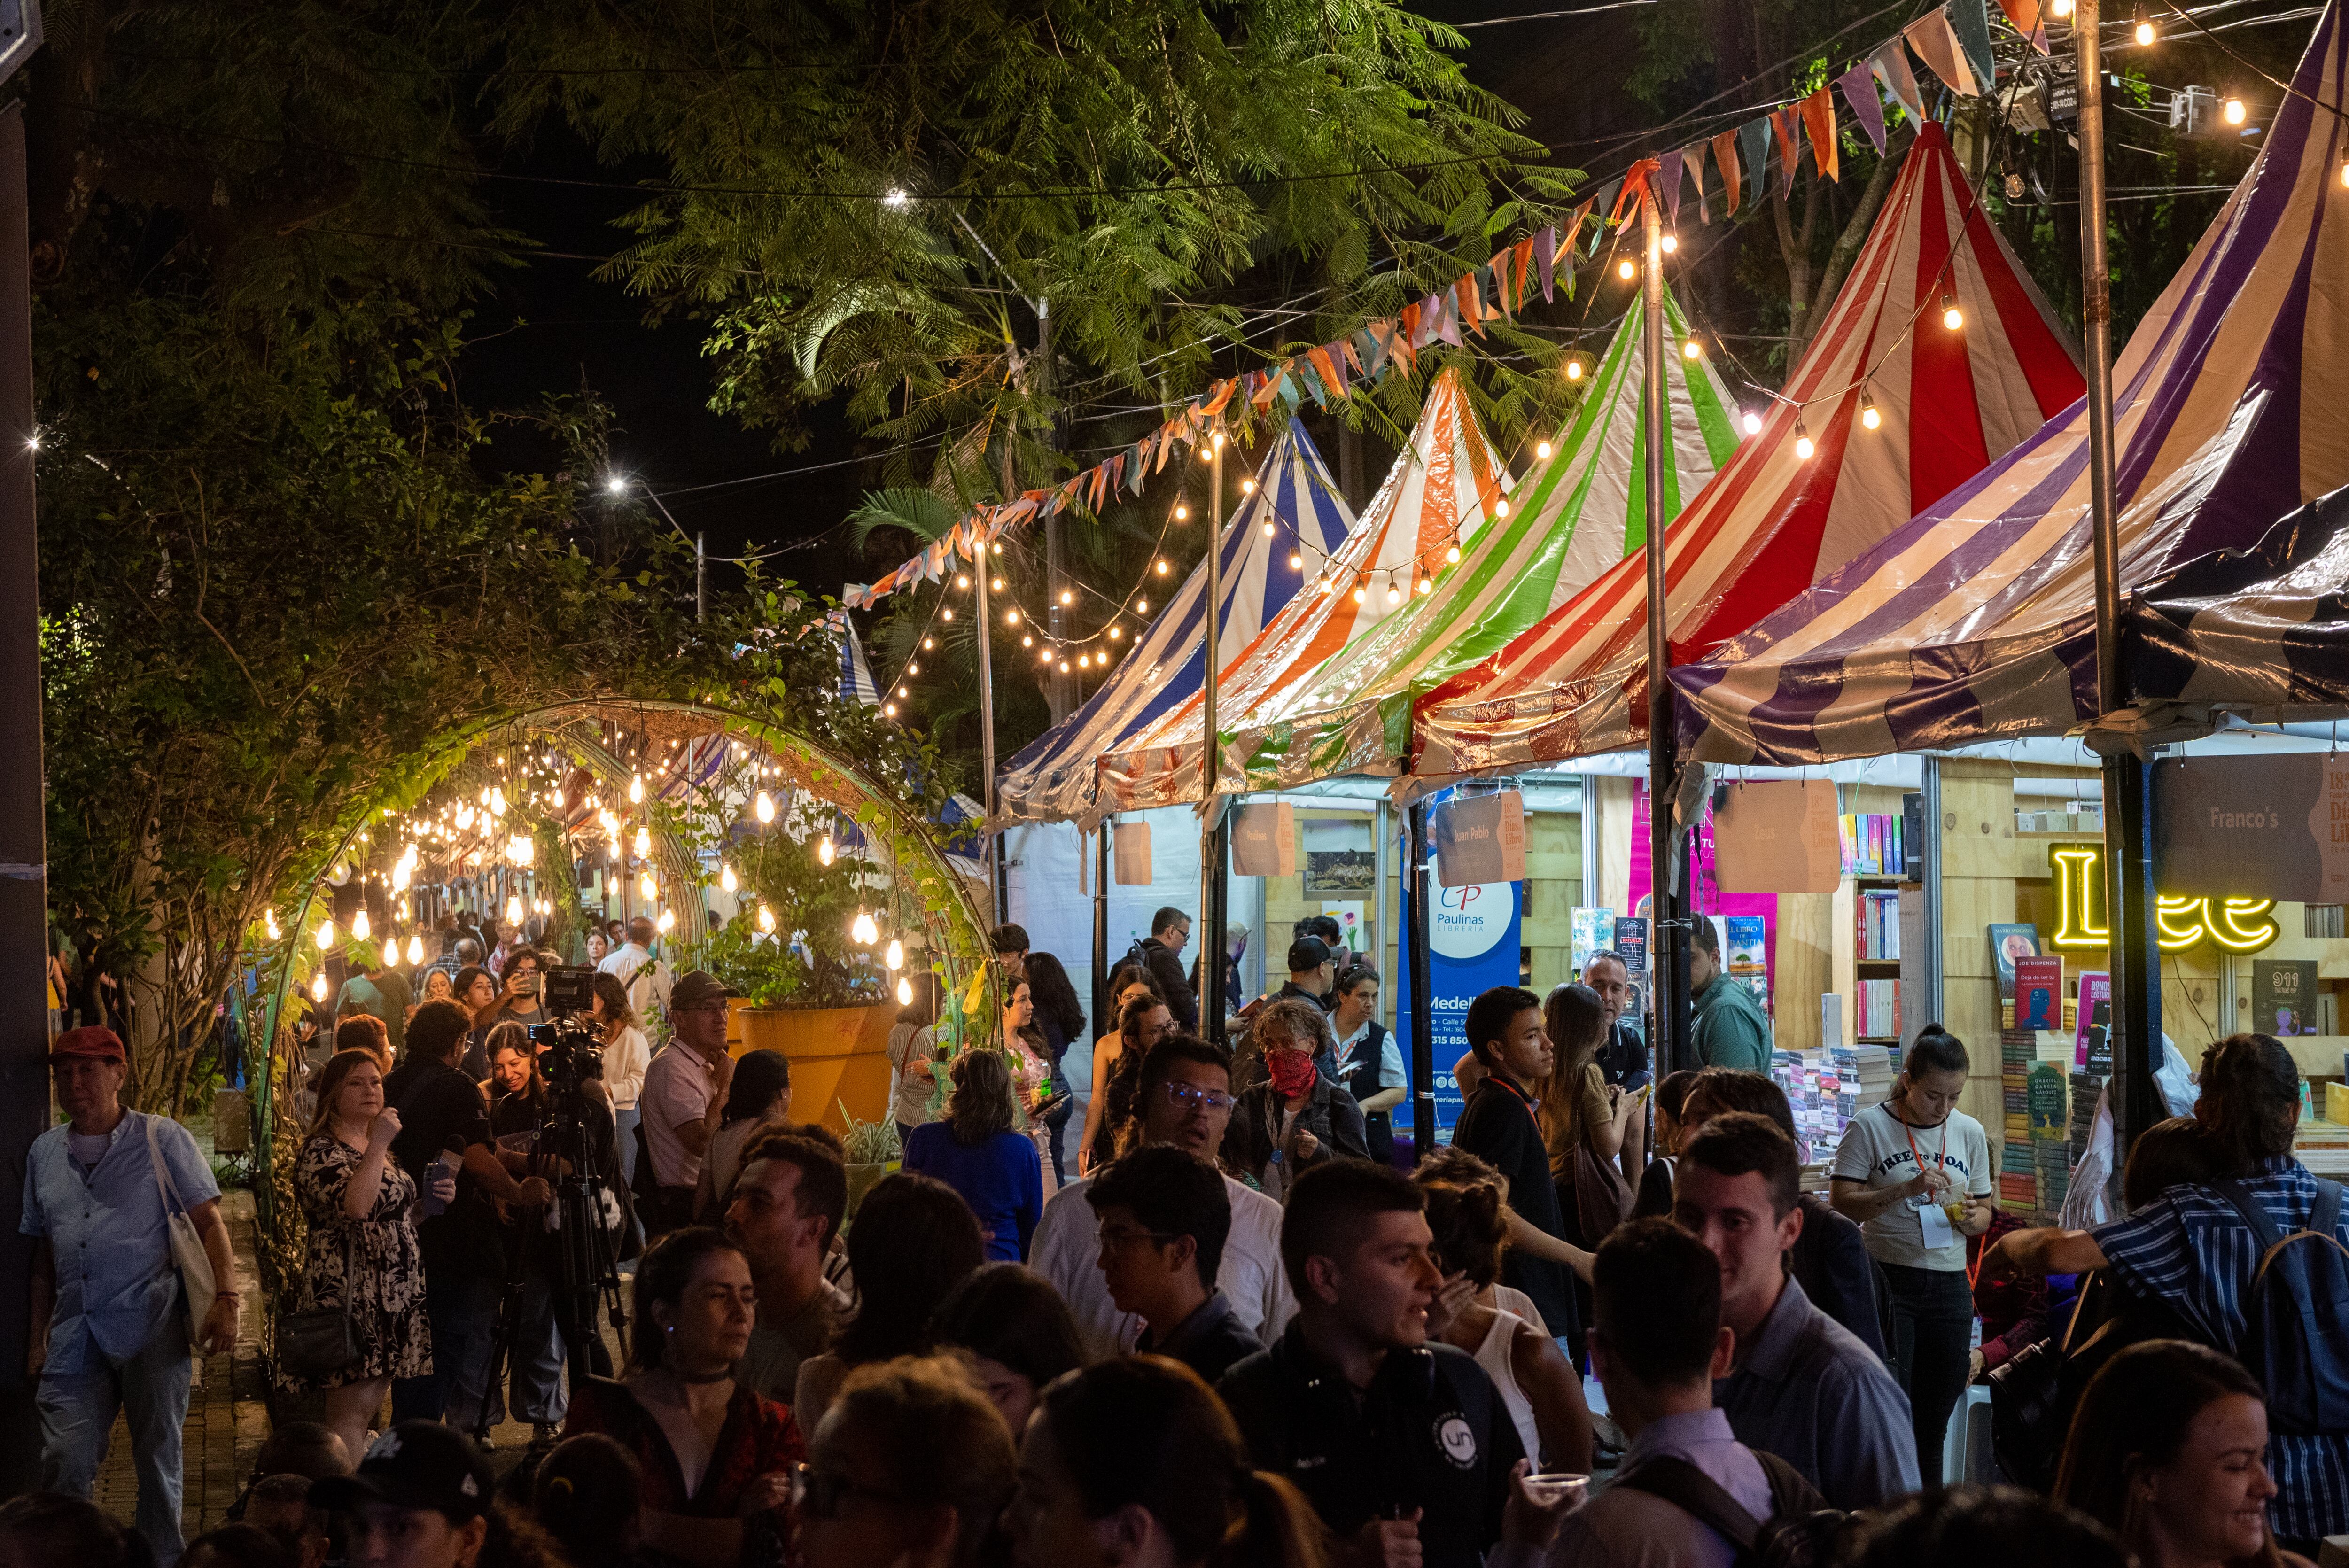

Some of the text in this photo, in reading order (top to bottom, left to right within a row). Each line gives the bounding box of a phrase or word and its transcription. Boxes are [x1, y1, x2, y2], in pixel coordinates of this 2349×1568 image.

[1247, 829, 1267, 841] Paulinas
[1455, 824, 1489, 843] Juan Pablo
[1505, 832, 1522, 845] Libro
[1438, 914, 1484, 924] Paulinas
[2272, 971, 2299, 987] 911
[1431, 1036, 1468, 1045] 315 850
[1877, 1150, 1913, 1176] FREE
